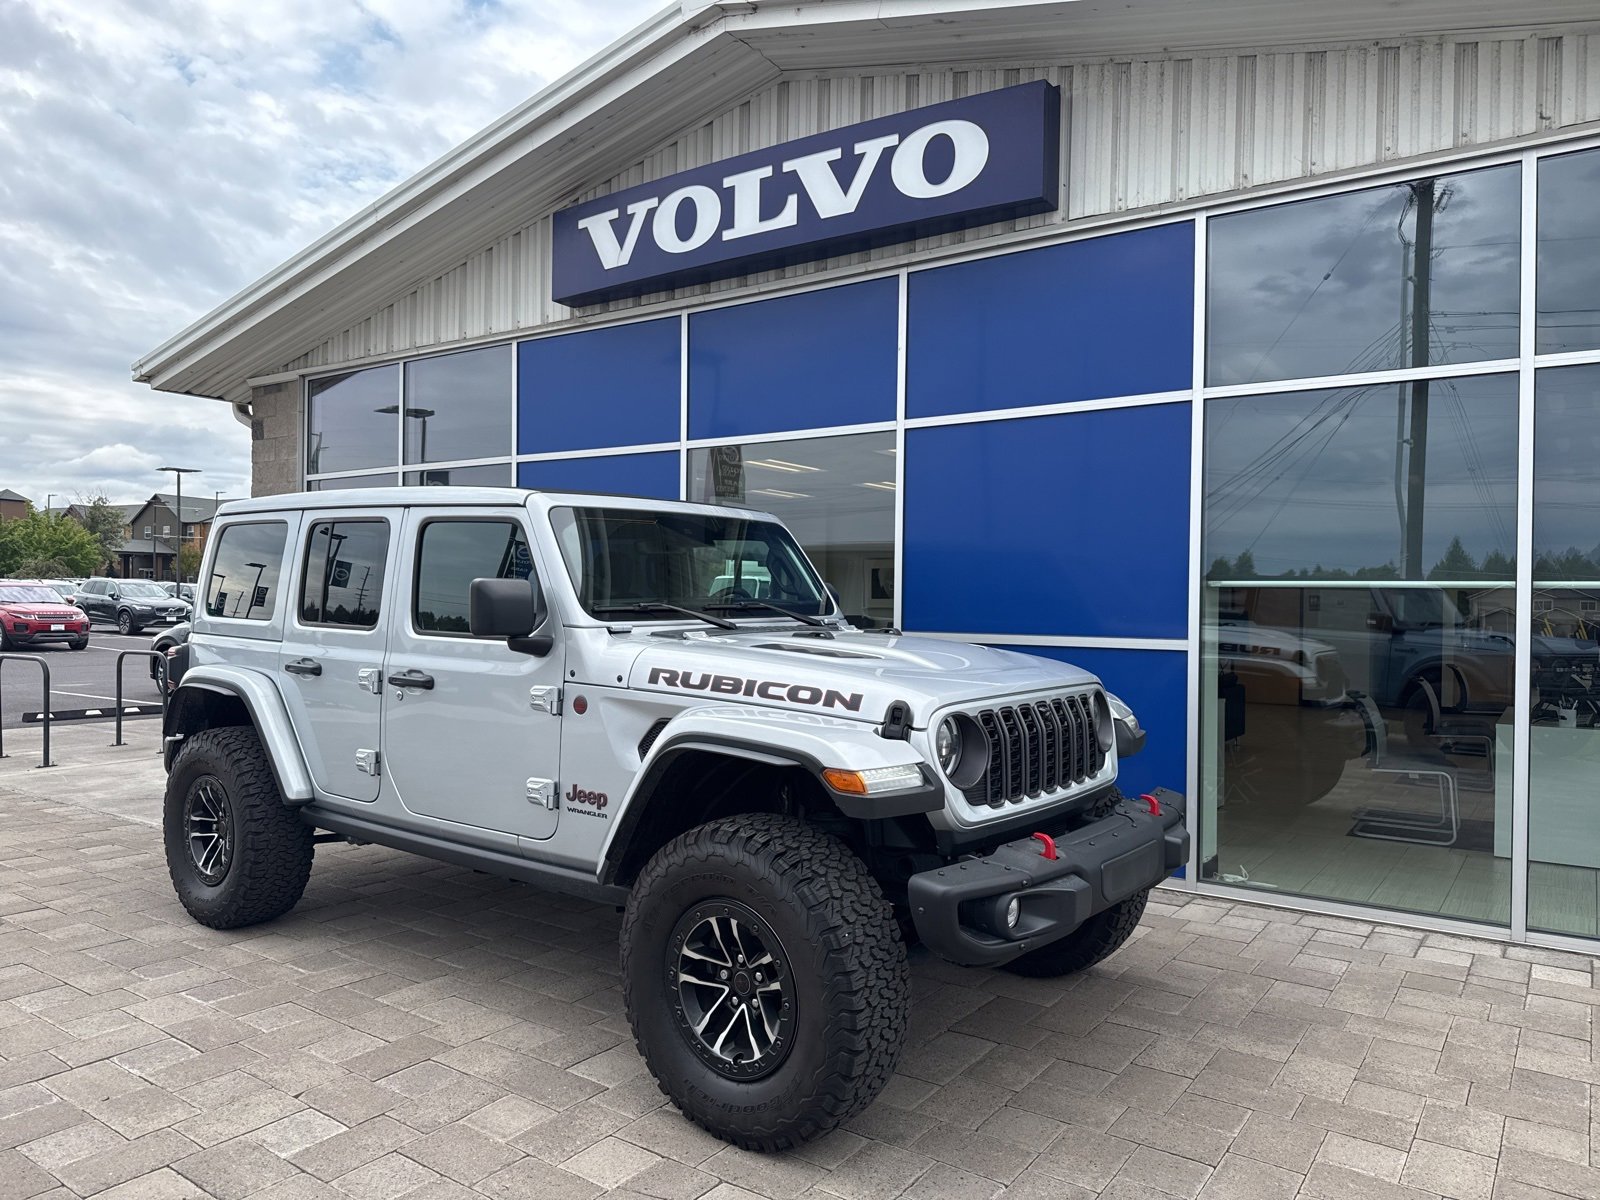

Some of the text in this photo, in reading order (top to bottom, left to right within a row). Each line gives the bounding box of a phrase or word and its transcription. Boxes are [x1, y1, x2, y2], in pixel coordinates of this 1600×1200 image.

[578, 119, 989, 270] VOLVO
[648, 667, 864, 712] RUBICON
[565, 783, 608, 811] Jeep
[566, 805, 608, 819] WRANGLER
